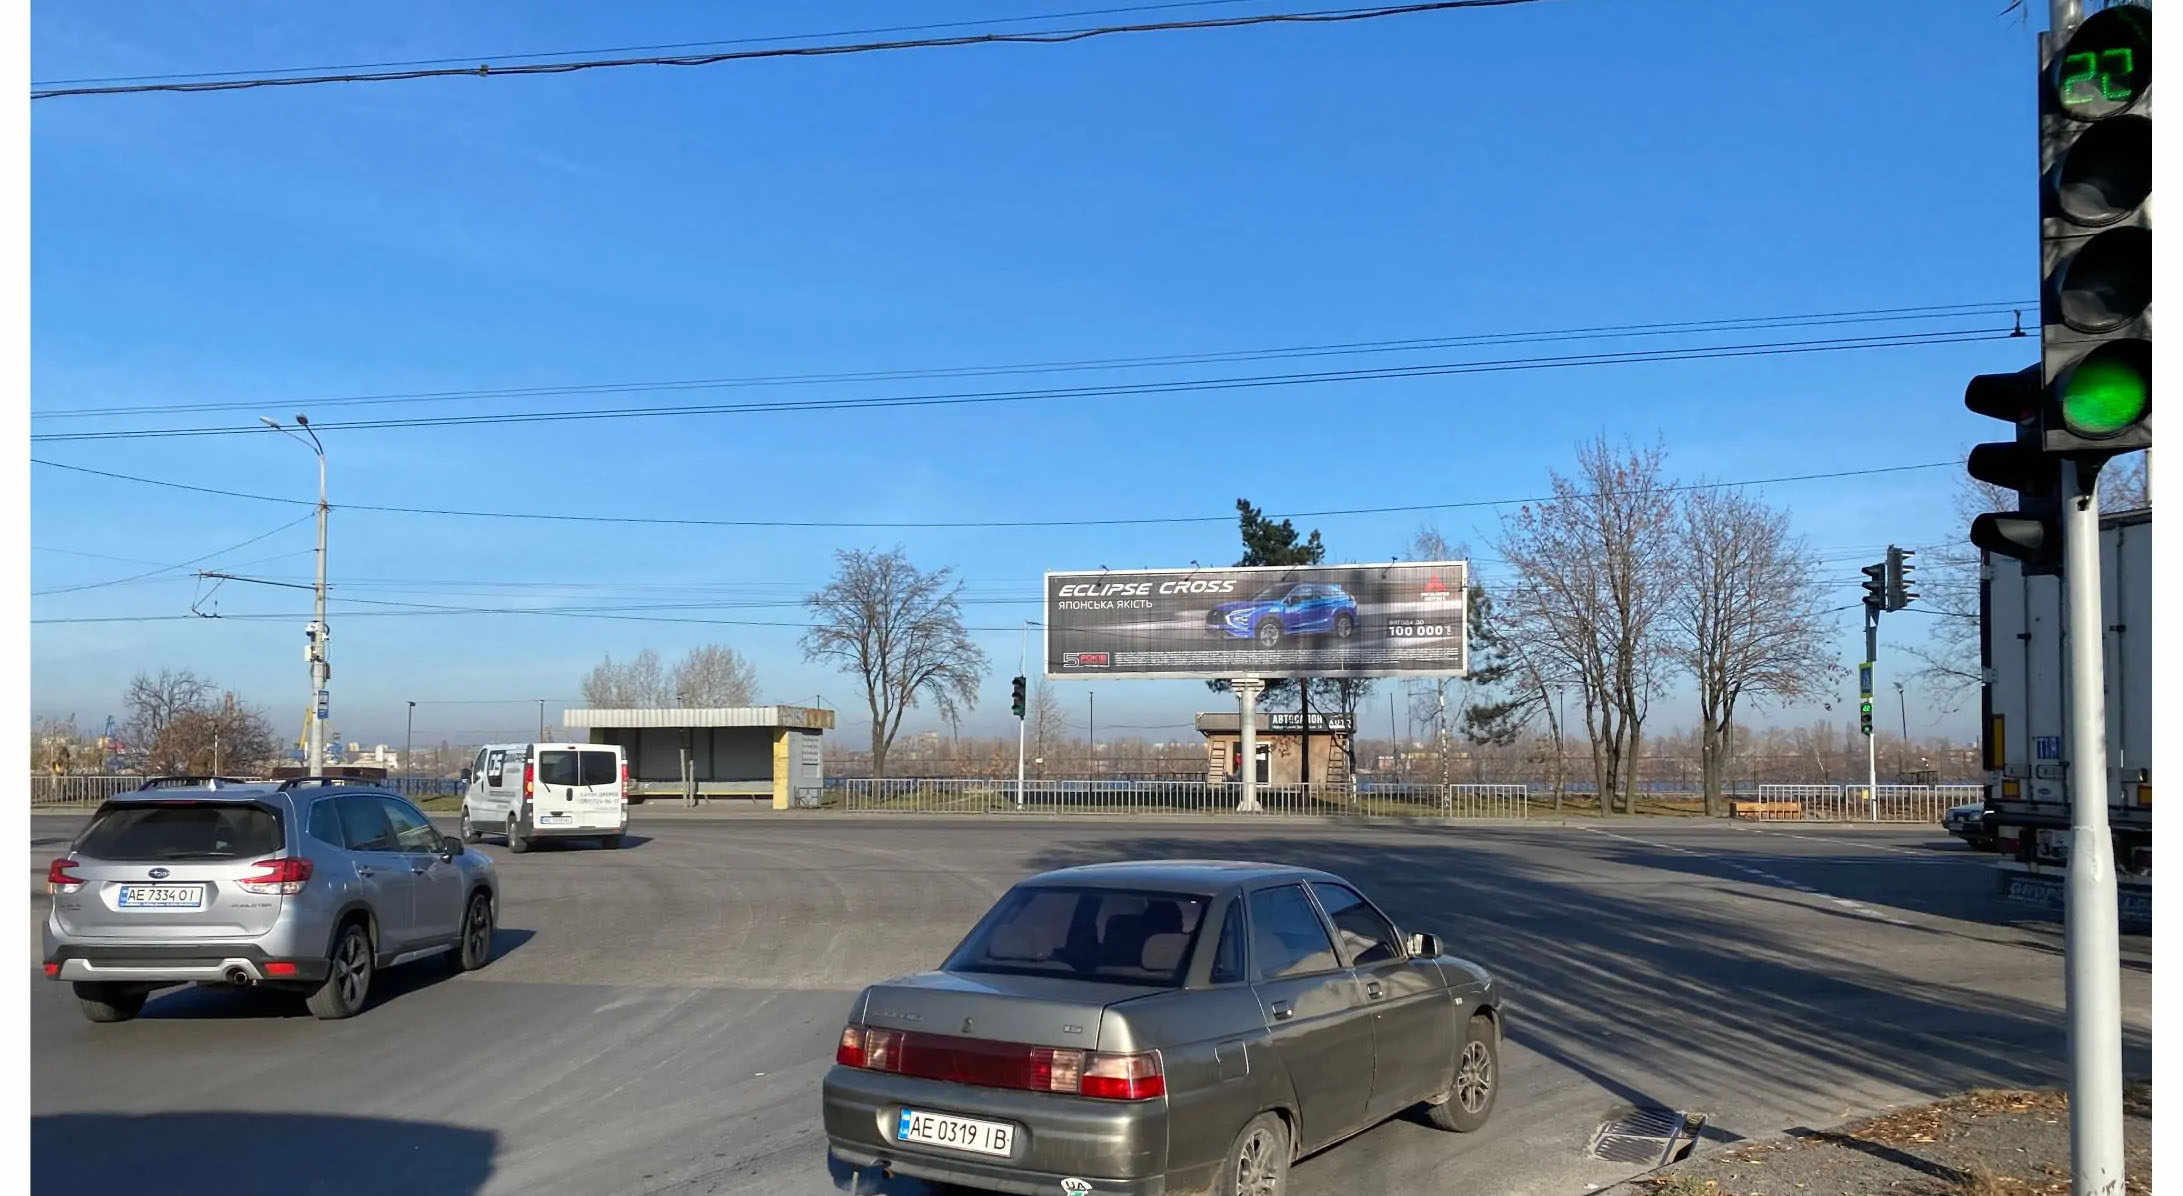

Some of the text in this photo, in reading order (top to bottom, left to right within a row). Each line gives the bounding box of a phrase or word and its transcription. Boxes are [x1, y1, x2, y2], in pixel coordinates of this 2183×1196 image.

[2063, 47, 2134, 105] 22
[1058, 580, 1237, 597] ECLIPSE CROSS
[1058, 599, 1153, 610] ЯПОНСЬКА ЯКІСТЬ
[1389, 626, 1413, 636] 100
[127, 889, 145, 901] AE
[148, 889, 176, 901] 7334
[910, 1115, 1007, 1150] AE 0319 IB
